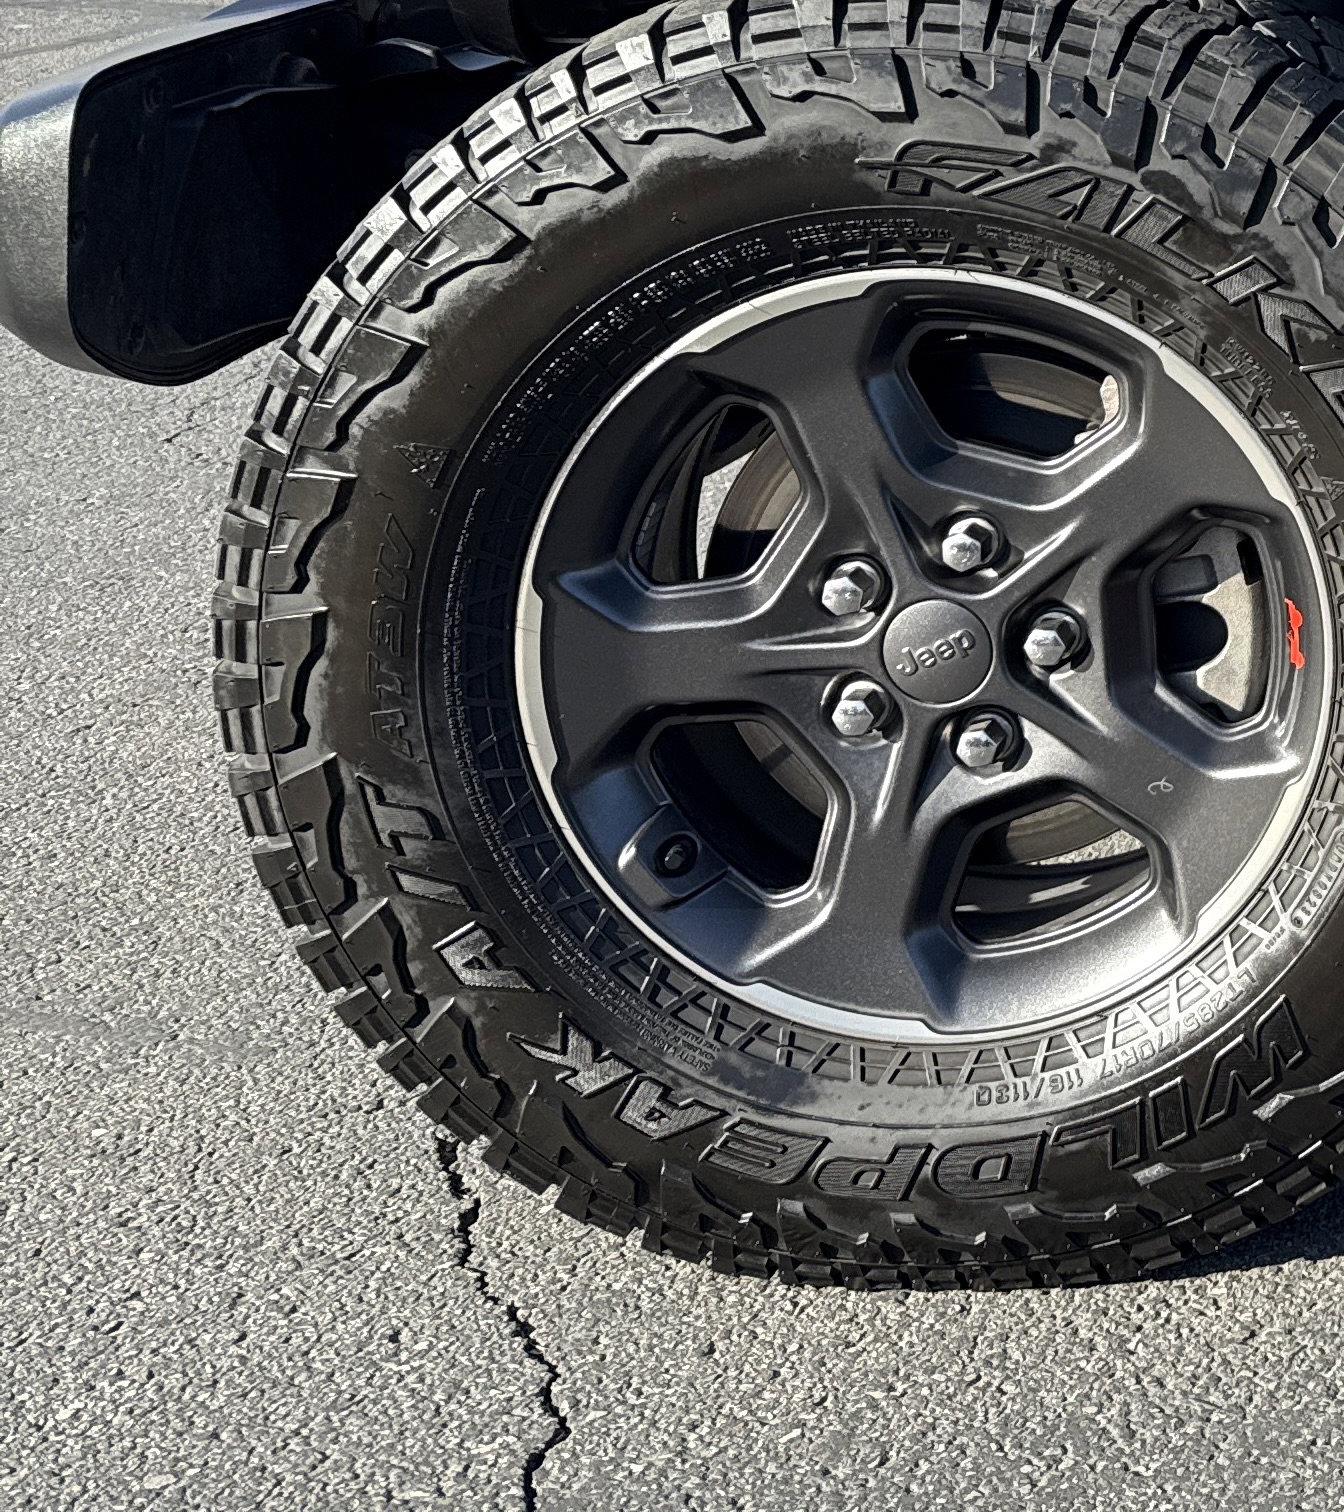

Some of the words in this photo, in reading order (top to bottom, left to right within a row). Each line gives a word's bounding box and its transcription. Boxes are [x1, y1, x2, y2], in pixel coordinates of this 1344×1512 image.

[895, 629, 976, 677] Jeep
[1099, 966, 1258, 1082] LT285/70R17
[506, 994, 1308, 1202] WILDPEAK
[974, 1067, 1084, 1107] 116/113Q
